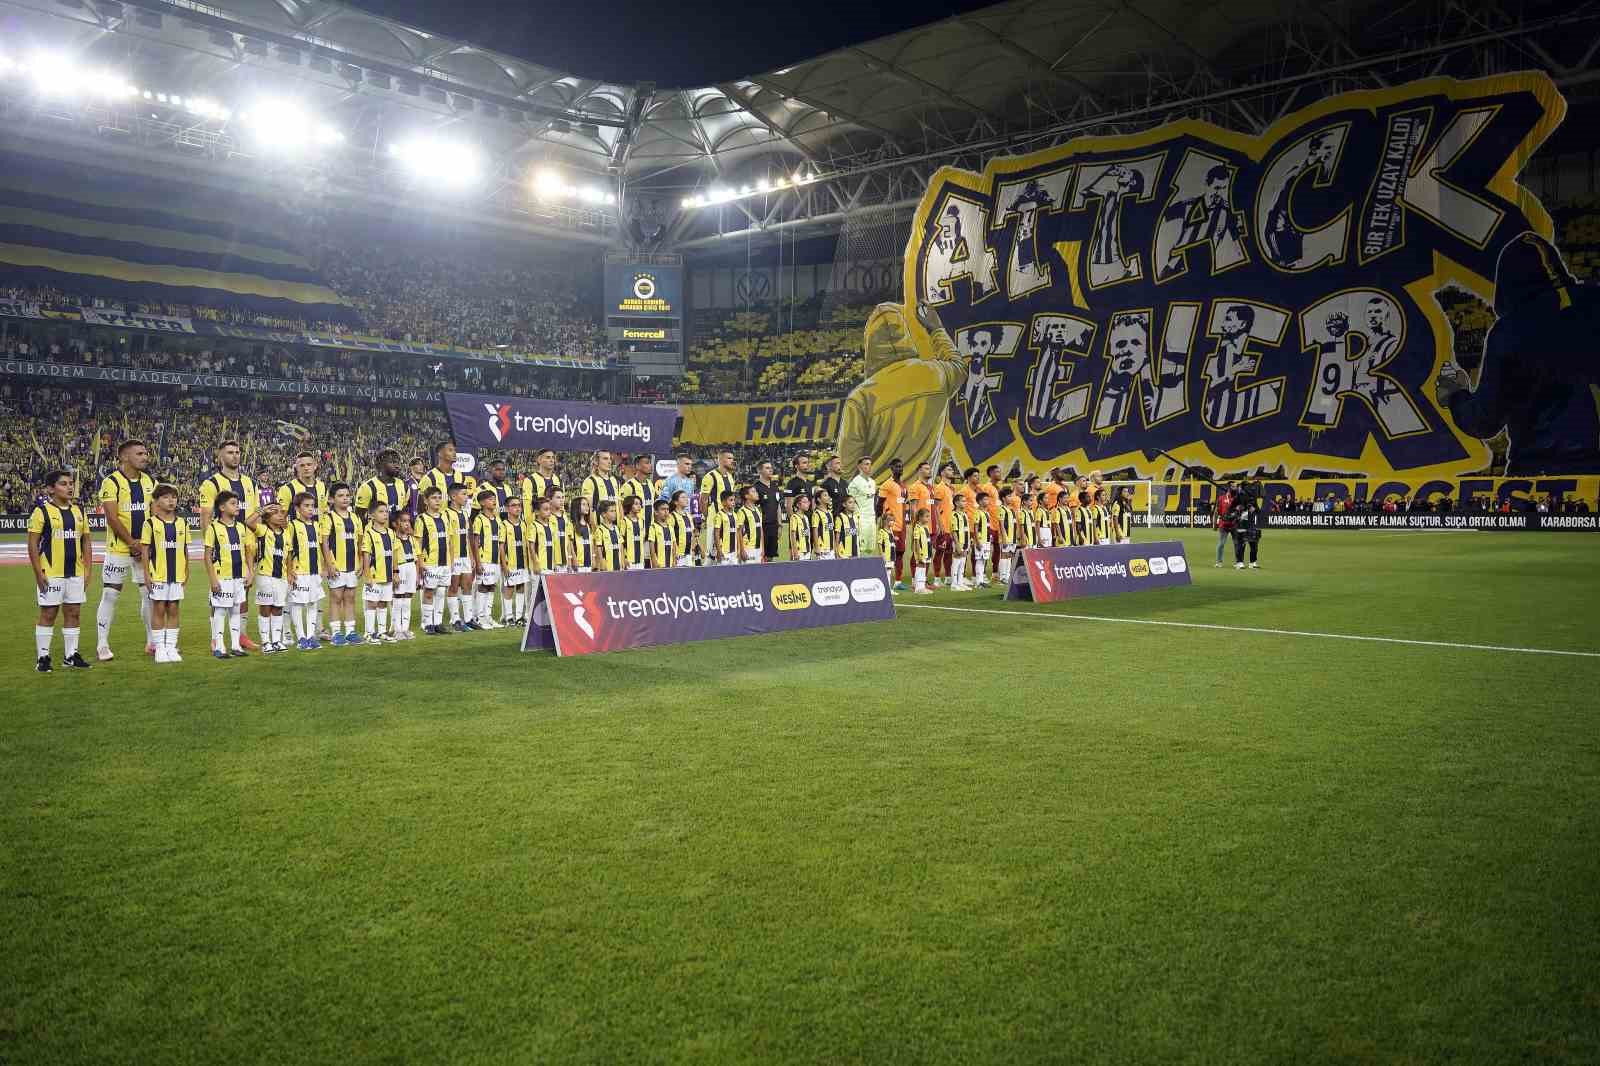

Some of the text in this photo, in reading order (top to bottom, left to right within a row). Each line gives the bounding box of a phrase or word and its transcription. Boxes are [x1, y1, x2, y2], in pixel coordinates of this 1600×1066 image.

[1387, 117, 1413, 159] KALDI
[1377, 163, 1400, 200] UZAY
[924, 106, 1504, 305] ATTACK
[1370, 203, 1392, 228] TEK
[955, 288, 1431, 436] FENER
[514, 411, 592, 438] trendyol
[1268, 515, 1311, 525] KARABORSA
[1334, 515, 1366, 526] SATMAK
[1368, 516, 1378, 526] VE
[1380, 516, 1407, 526] ALMAK
[1468, 517, 1497, 527] ORTAK
[1541, 517, 1596, 528] KARABORSA
[1054, 560, 1096, 581] trendyol
[607, 590, 763, 619] trendyol süperLig
